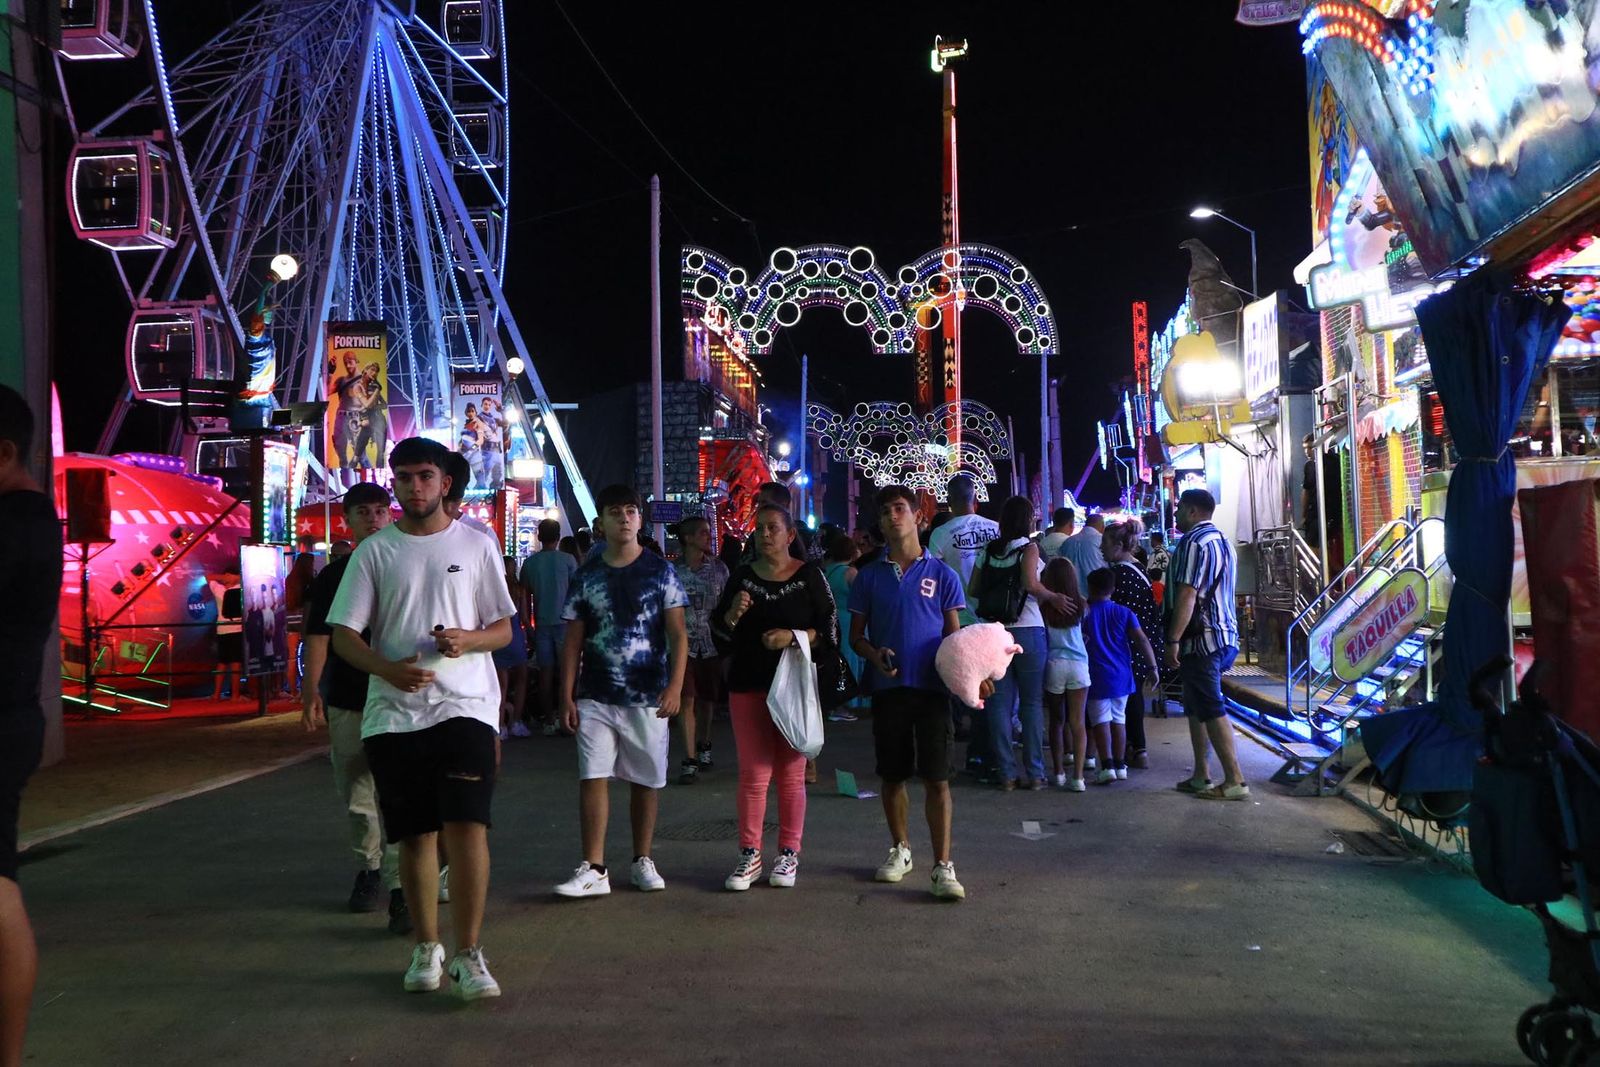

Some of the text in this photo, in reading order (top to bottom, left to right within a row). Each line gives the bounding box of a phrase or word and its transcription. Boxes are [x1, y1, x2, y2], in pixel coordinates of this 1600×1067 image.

[334, 335, 380, 348] FORTNITE
[460, 384, 497, 394] FORTNITE
[921, 578, 937, 598] 9
[188, 602, 206, 611] NASA
[1345, 585, 1418, 667] TAQUILLA
